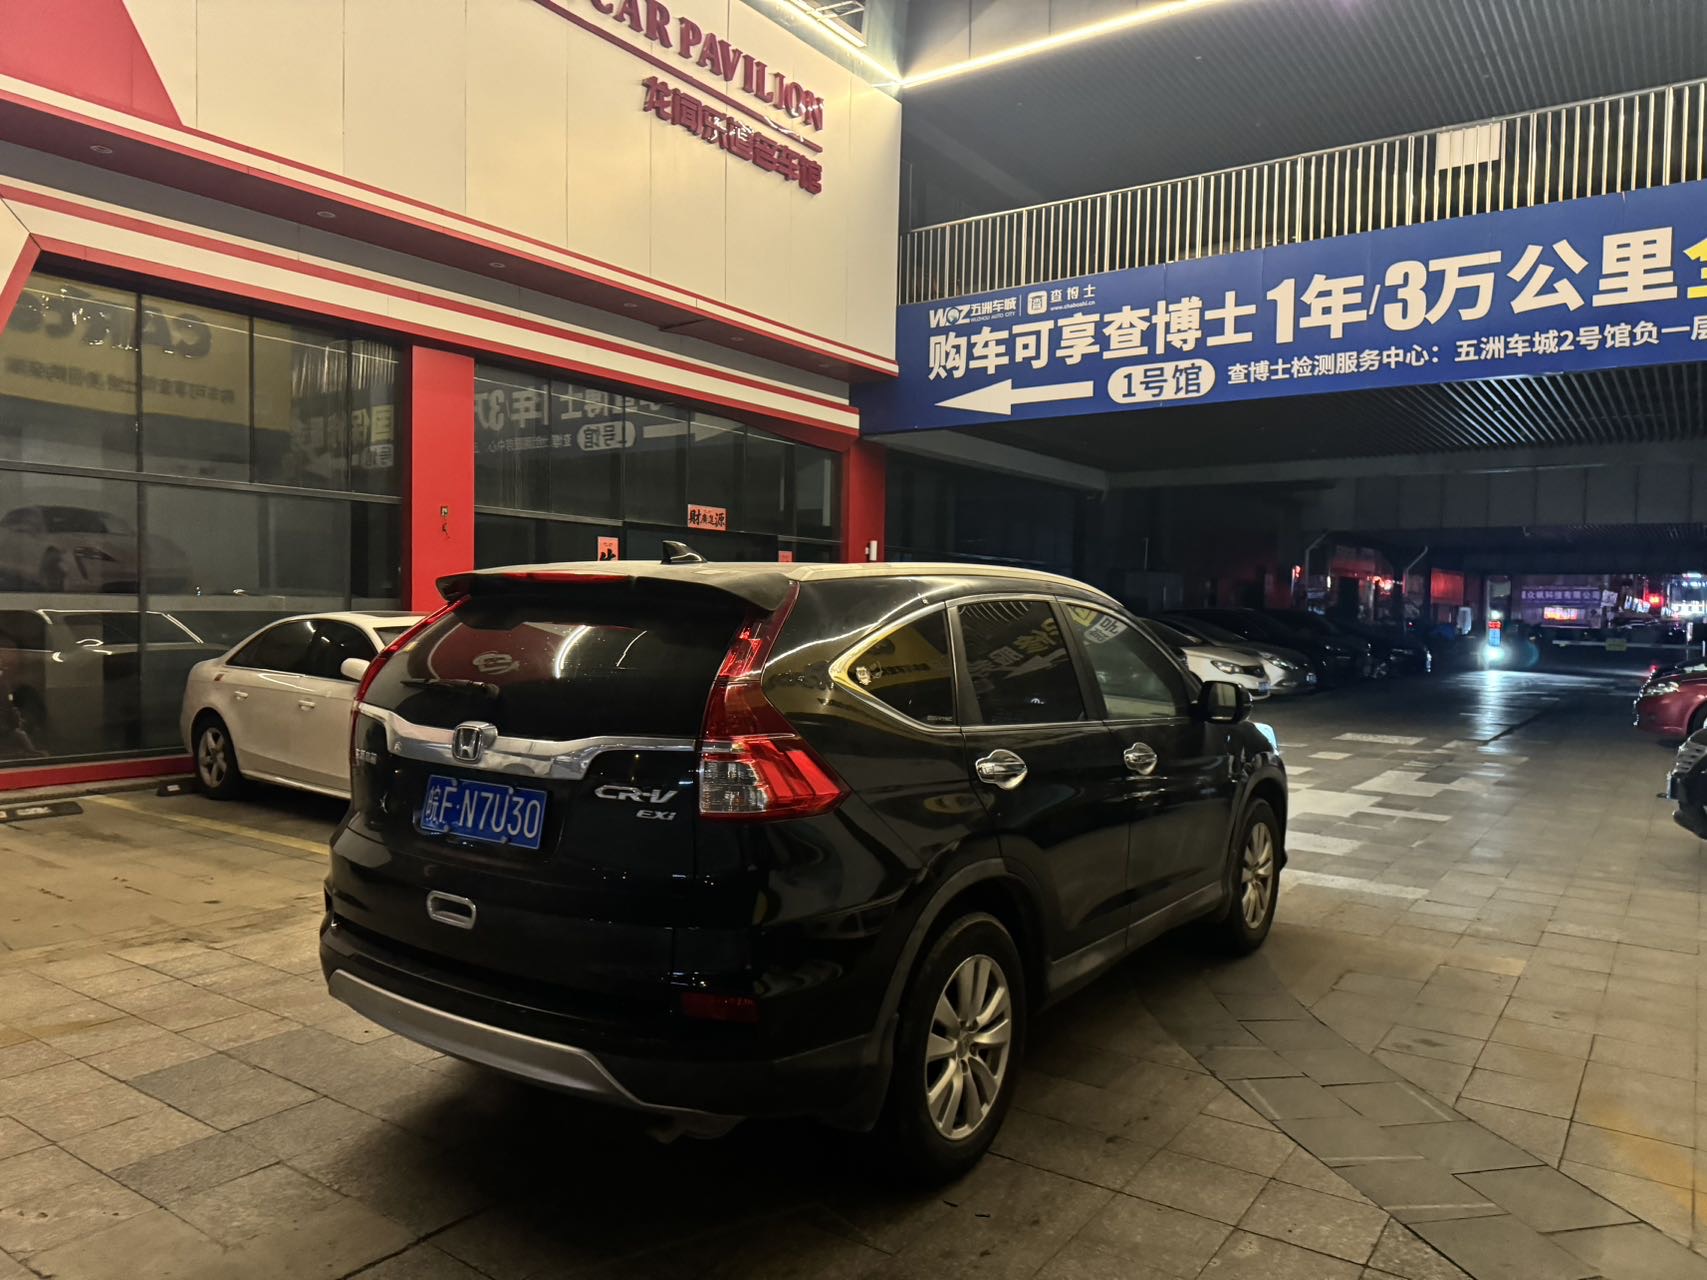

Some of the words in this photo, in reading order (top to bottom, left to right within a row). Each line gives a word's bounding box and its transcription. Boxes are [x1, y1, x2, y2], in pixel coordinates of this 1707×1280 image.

[678, 17, 824, 131] PAVILION
[970, 297, 1017, 317] 五洲车城
[1122, 363, 1202, 398] 1号馆
[595, 784, 679, 803] CR-V
